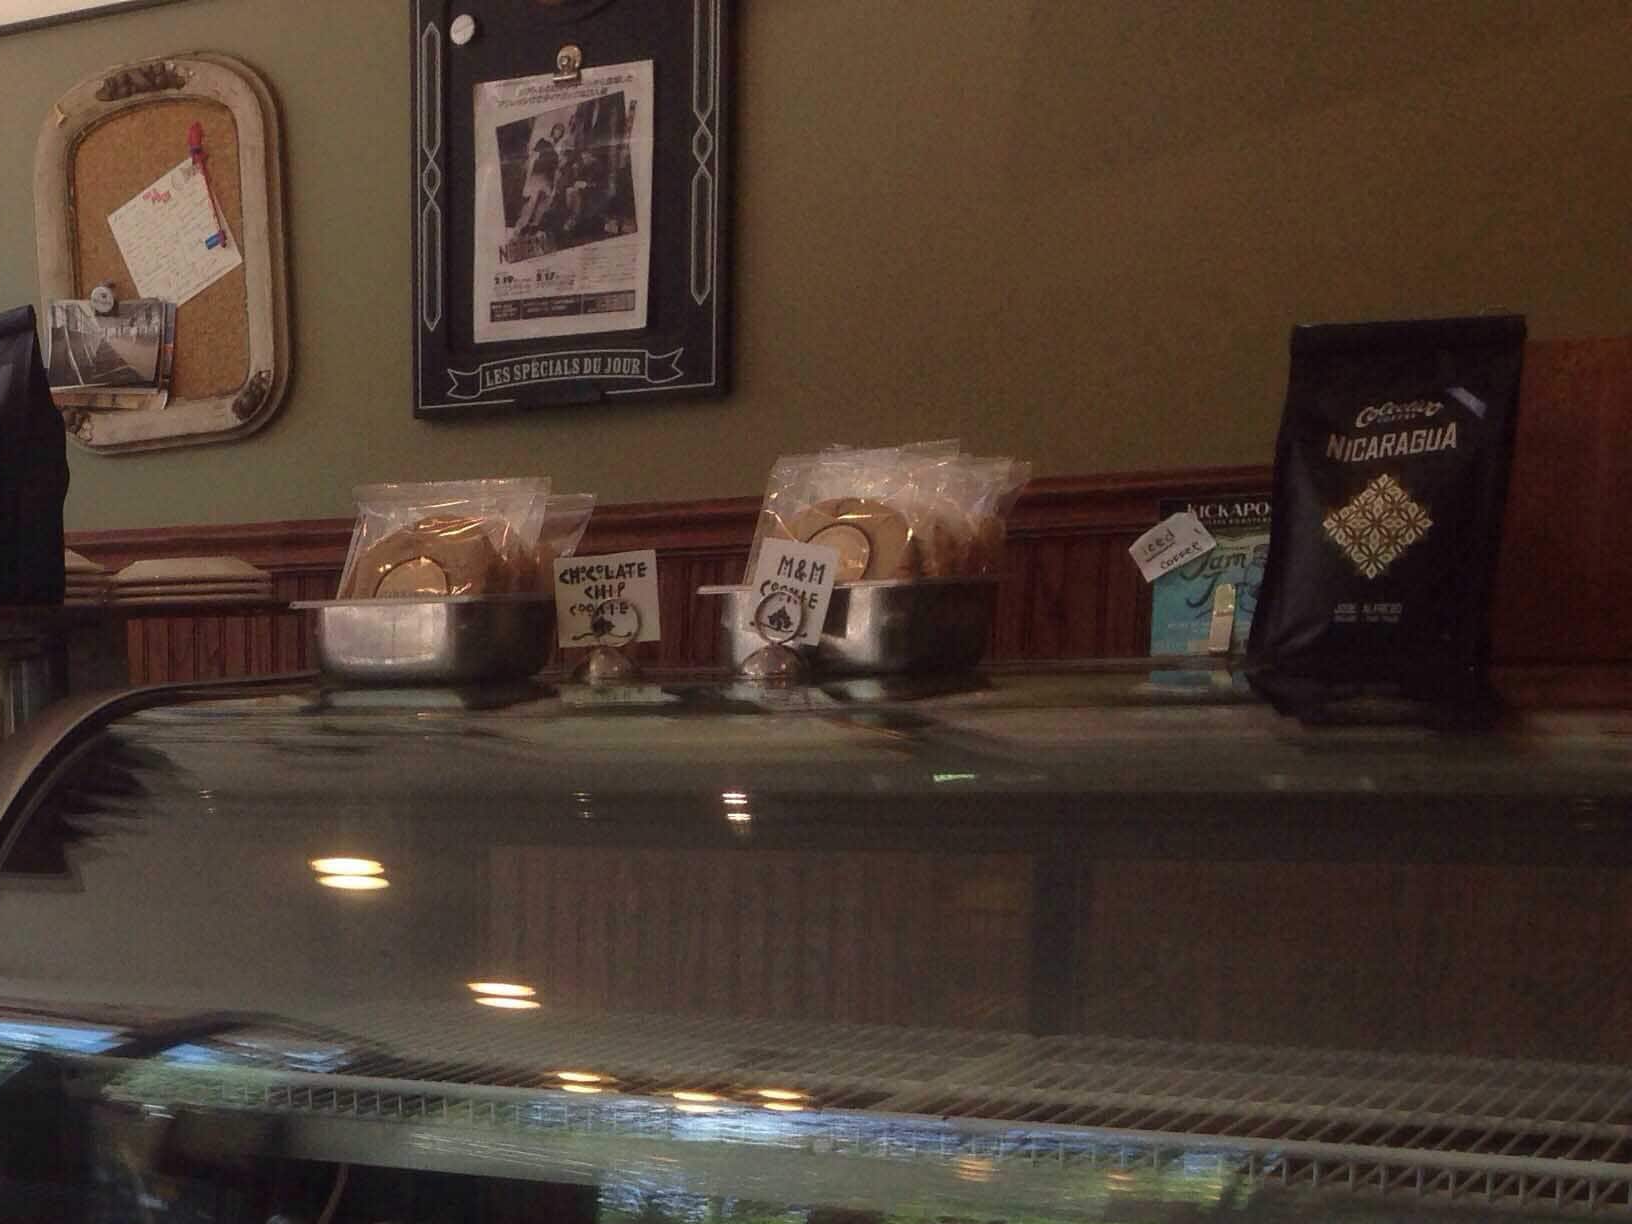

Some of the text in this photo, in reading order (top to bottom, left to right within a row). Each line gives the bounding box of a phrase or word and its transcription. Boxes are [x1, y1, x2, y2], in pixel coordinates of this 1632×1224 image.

[485, 367, 510, 387] LES
[583, 358, 602, 373] DU
[604, 357, 641, 375] JOUR
[1327, 422, 1457, 463] NICARAGUA
[777, 555, 826, 584] M&M
[584, 582, 626, 599] CHIP
